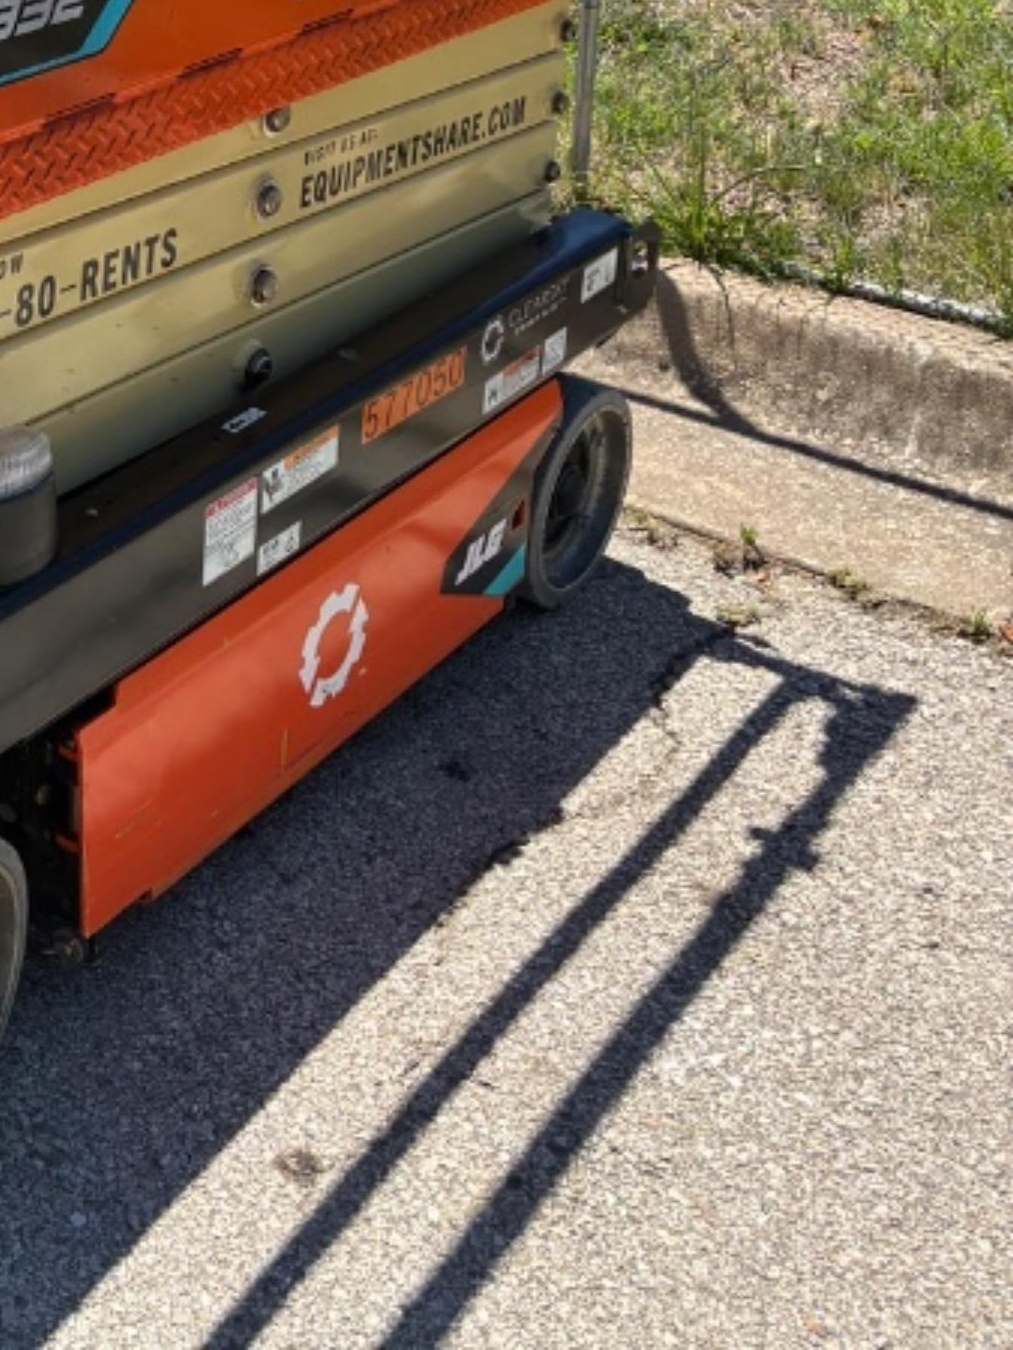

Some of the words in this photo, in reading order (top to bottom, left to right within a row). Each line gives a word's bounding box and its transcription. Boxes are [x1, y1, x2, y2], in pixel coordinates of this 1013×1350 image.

[300, 96, 527, 208] EQUIPMENTSHARE.COM
[364, 350, 463, 438] 577050
[454, 518, 508, 586] JLG
